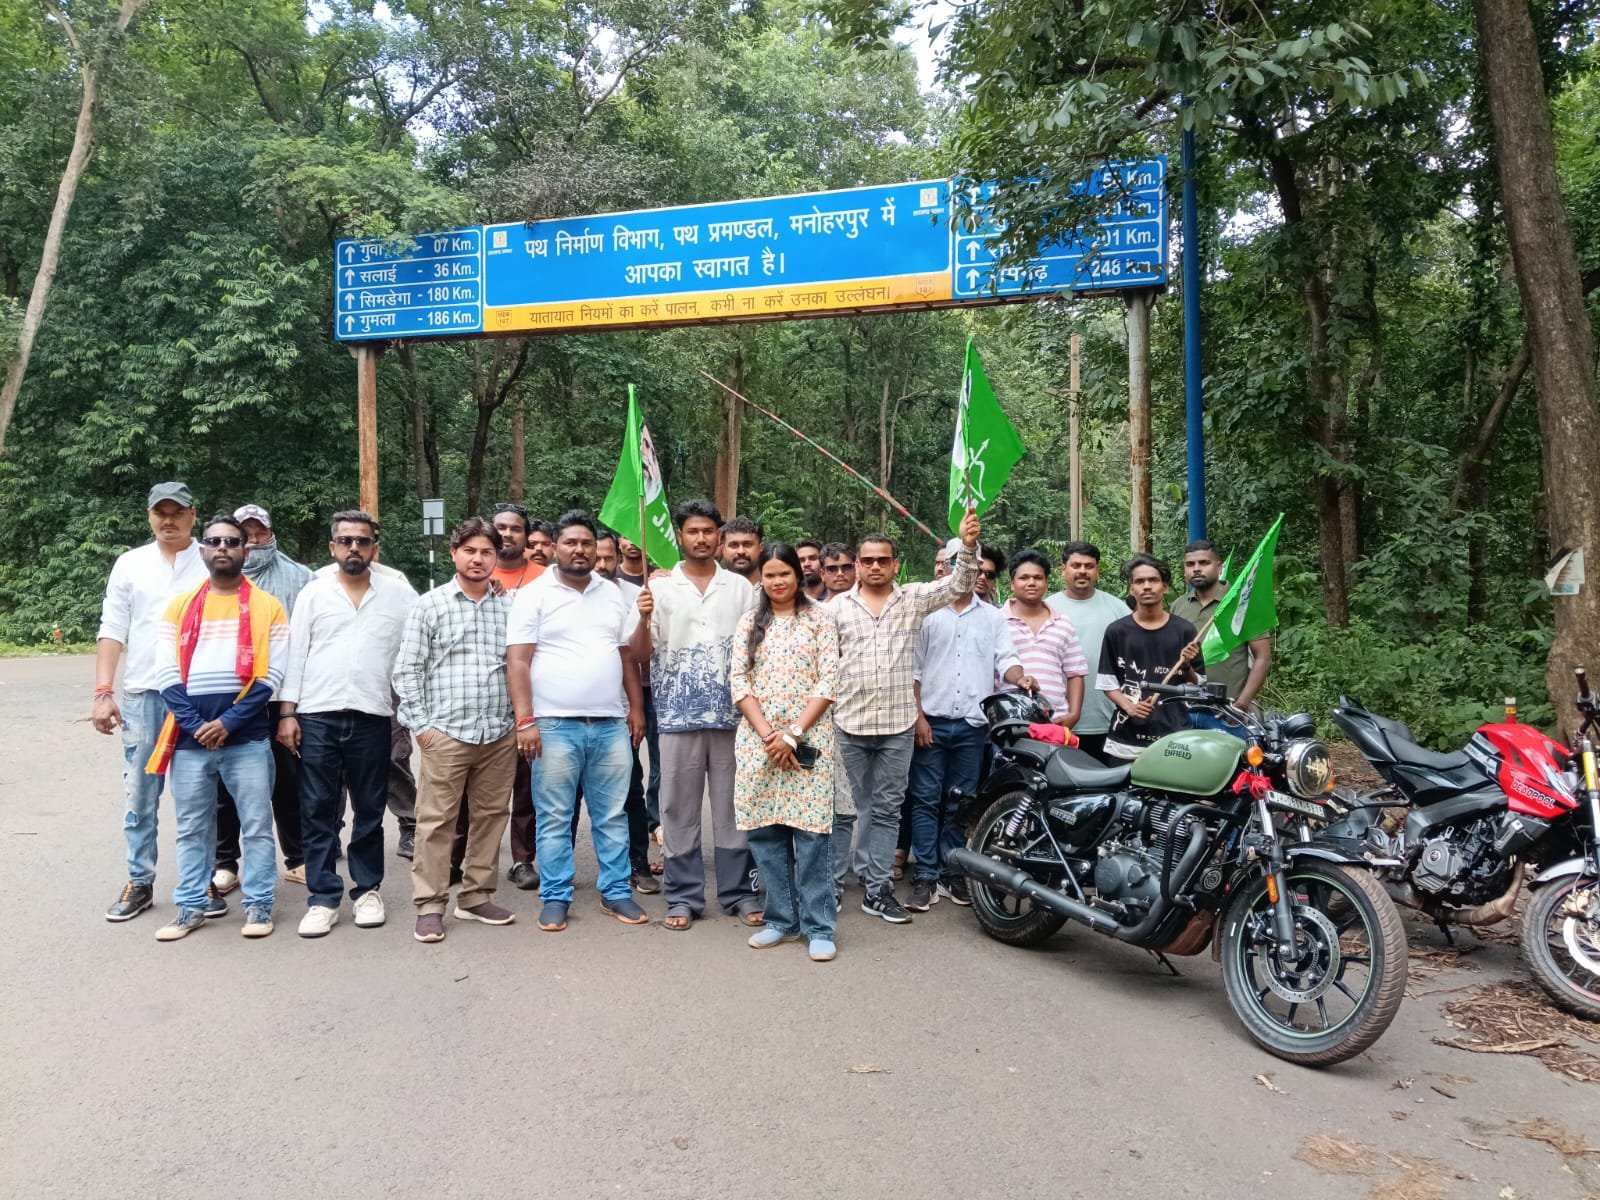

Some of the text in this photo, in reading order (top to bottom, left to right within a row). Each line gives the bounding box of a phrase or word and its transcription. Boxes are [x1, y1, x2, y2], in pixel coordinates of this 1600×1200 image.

[524, 196, 896, 259] पथ निर्माण विभाग, पथ प्रमण्डल, मनोहरपुर में
[1126, 228, 1156, 245] Km.
[433, 238, 449, 253] 07
[452, 235, 475, 251] Km.
[360, 264, 397, 283] सलाई
[433, 263, 449, 278] 36
[452, 260, 475, 276] Km.
[625, 261, 682, 284] आपका
[693, 255, 750, 280] स्वागत
[360, 288, 411, 308] सिमडेगा
[427, 286, 449, 302] 180
[452, 284, 475, 300] Km.
[530, 307, 574, 324] यातायात
[580, 302, 613, 321] नियमों
[619, 305, 634, 319] का
[640, 299, 659, 317] करें
[711, 294, 735, 313] कभी
[743, 296, 755, 310] ना
[765, 290, 784, 308] करें
[791, 290, 827, 306] उनका
[360, 313, 396, 333] गुमला
[427, 311, 449, 326] 186
[452, 308, 475, 324] Km.
[1164, 749, 1192, 760] ENFIELD
[1511, 780, 1555, 808] DEADPOOL
